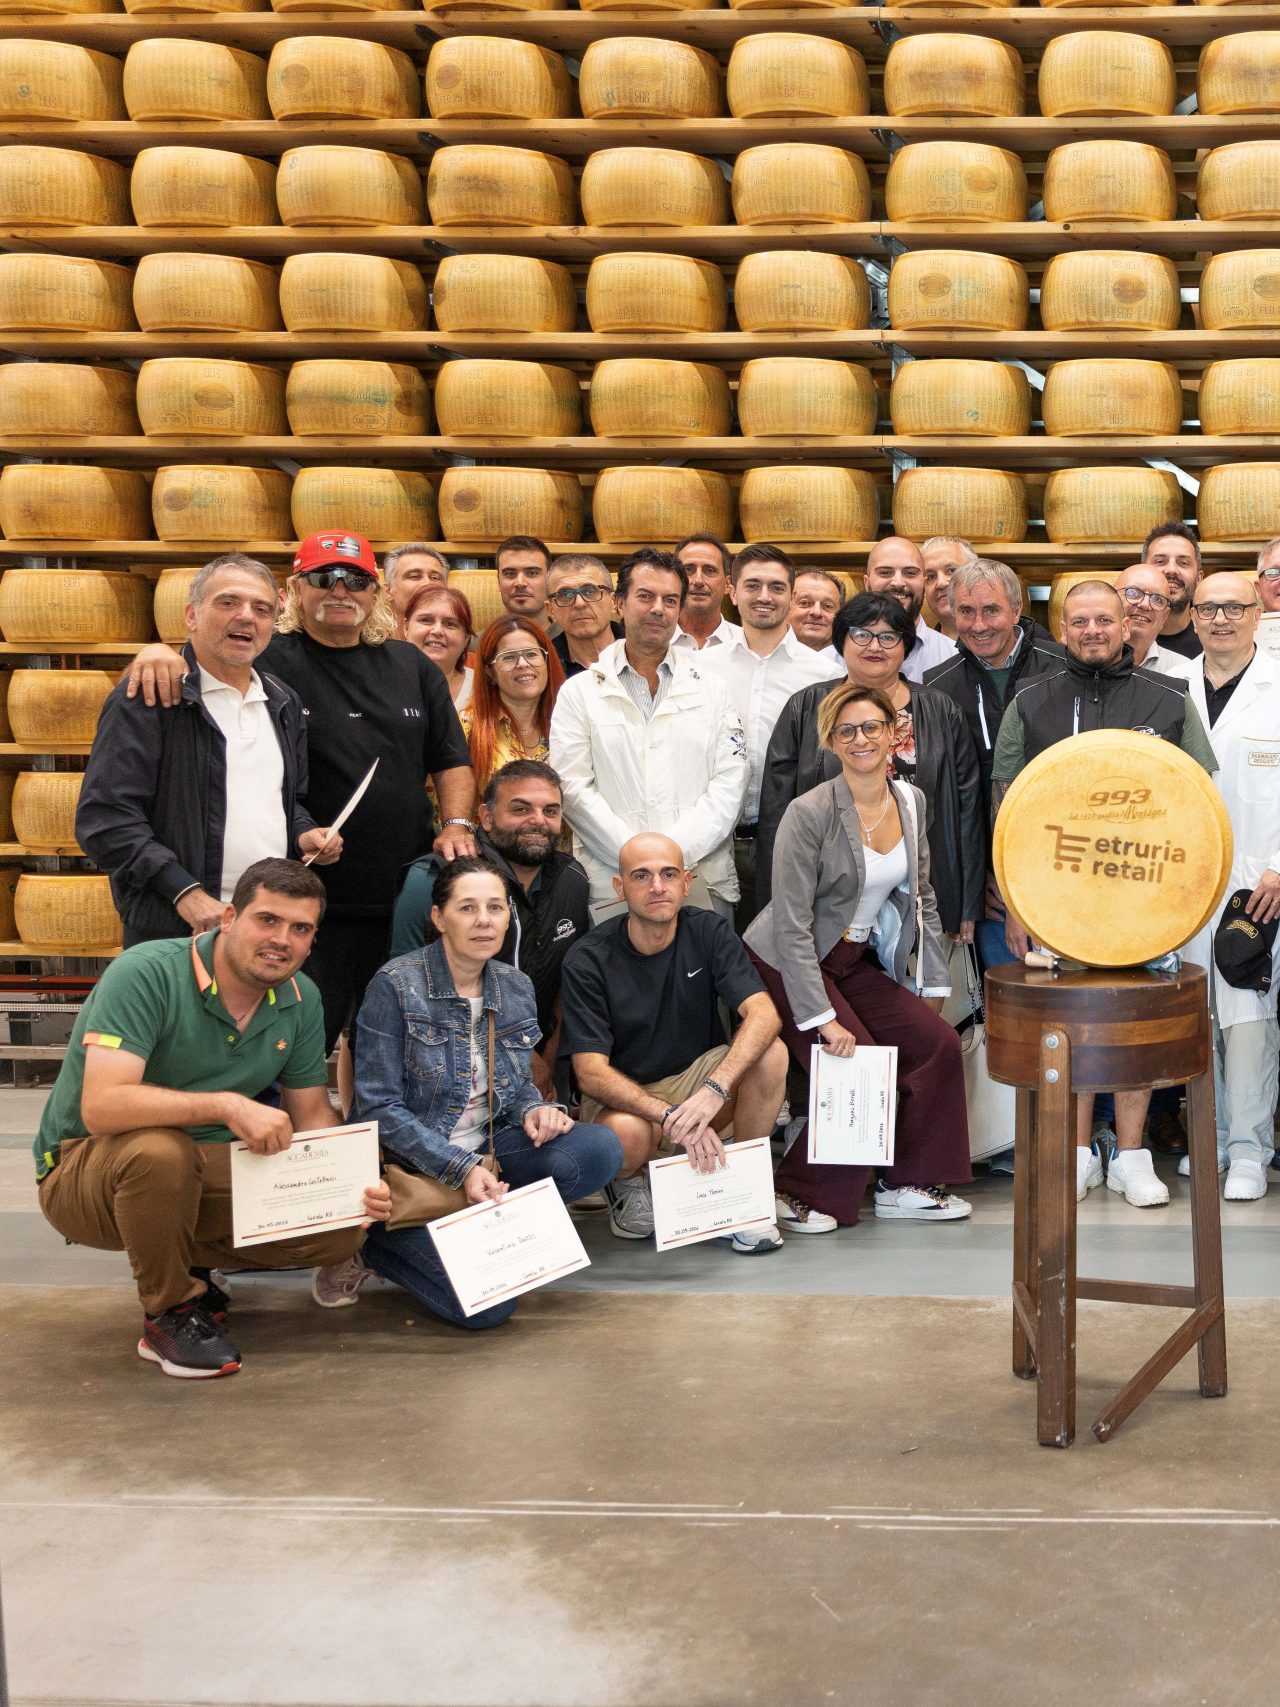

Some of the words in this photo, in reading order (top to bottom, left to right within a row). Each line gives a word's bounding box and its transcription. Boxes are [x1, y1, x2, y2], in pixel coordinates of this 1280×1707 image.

[1260, 306, 1275, 314] FEB
[1087, 789, 1152, 807] 993
[1094, 835, 1187, 864] etruria
[1092, 858, 1165, 884] retail
